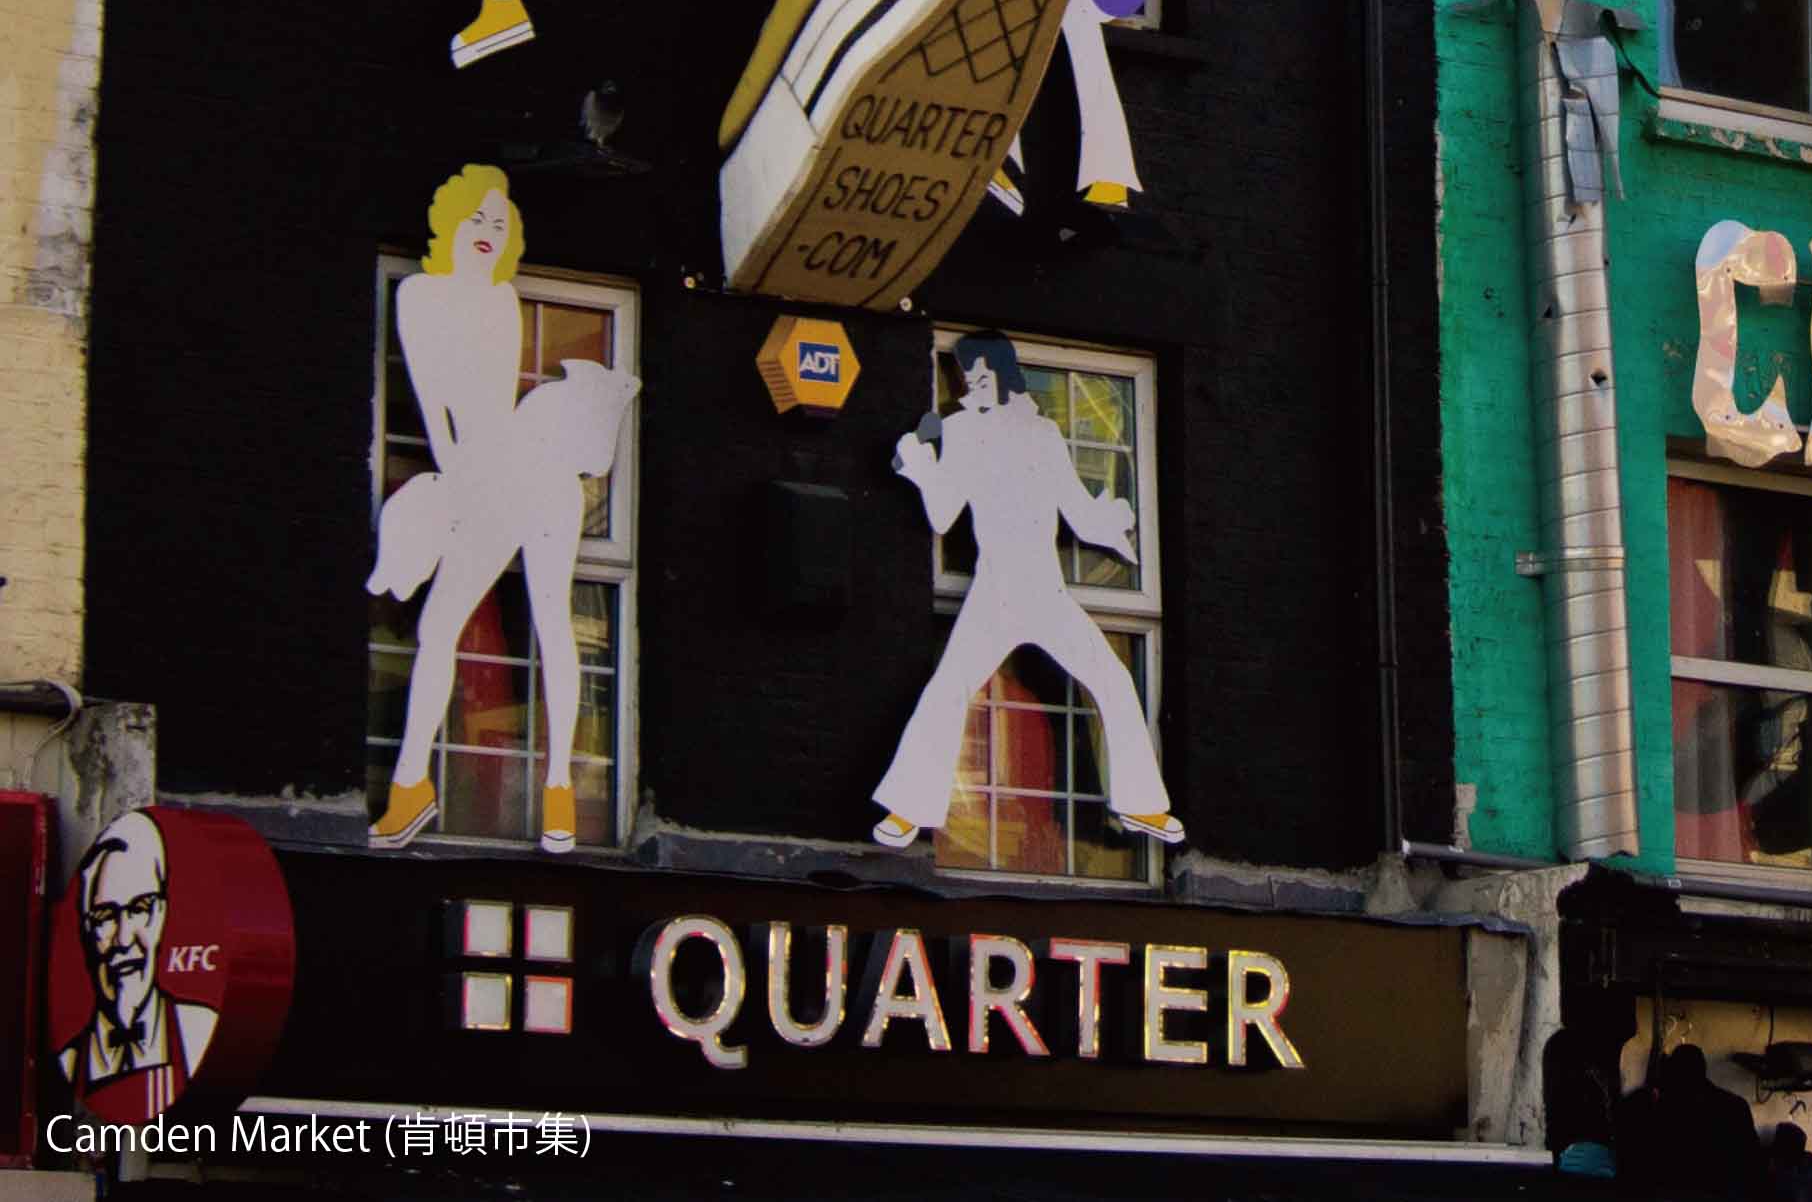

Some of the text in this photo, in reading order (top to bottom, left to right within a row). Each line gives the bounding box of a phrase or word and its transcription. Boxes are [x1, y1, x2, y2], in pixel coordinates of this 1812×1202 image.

[841, 94, 1007, 162] QUARTER
[823, 165, 949, 222] SHOES
[799, 350, 840, 375] ADT
[167, 944, 220, 973] KFC
[650, 915, 1305, 1070] QUARTER
